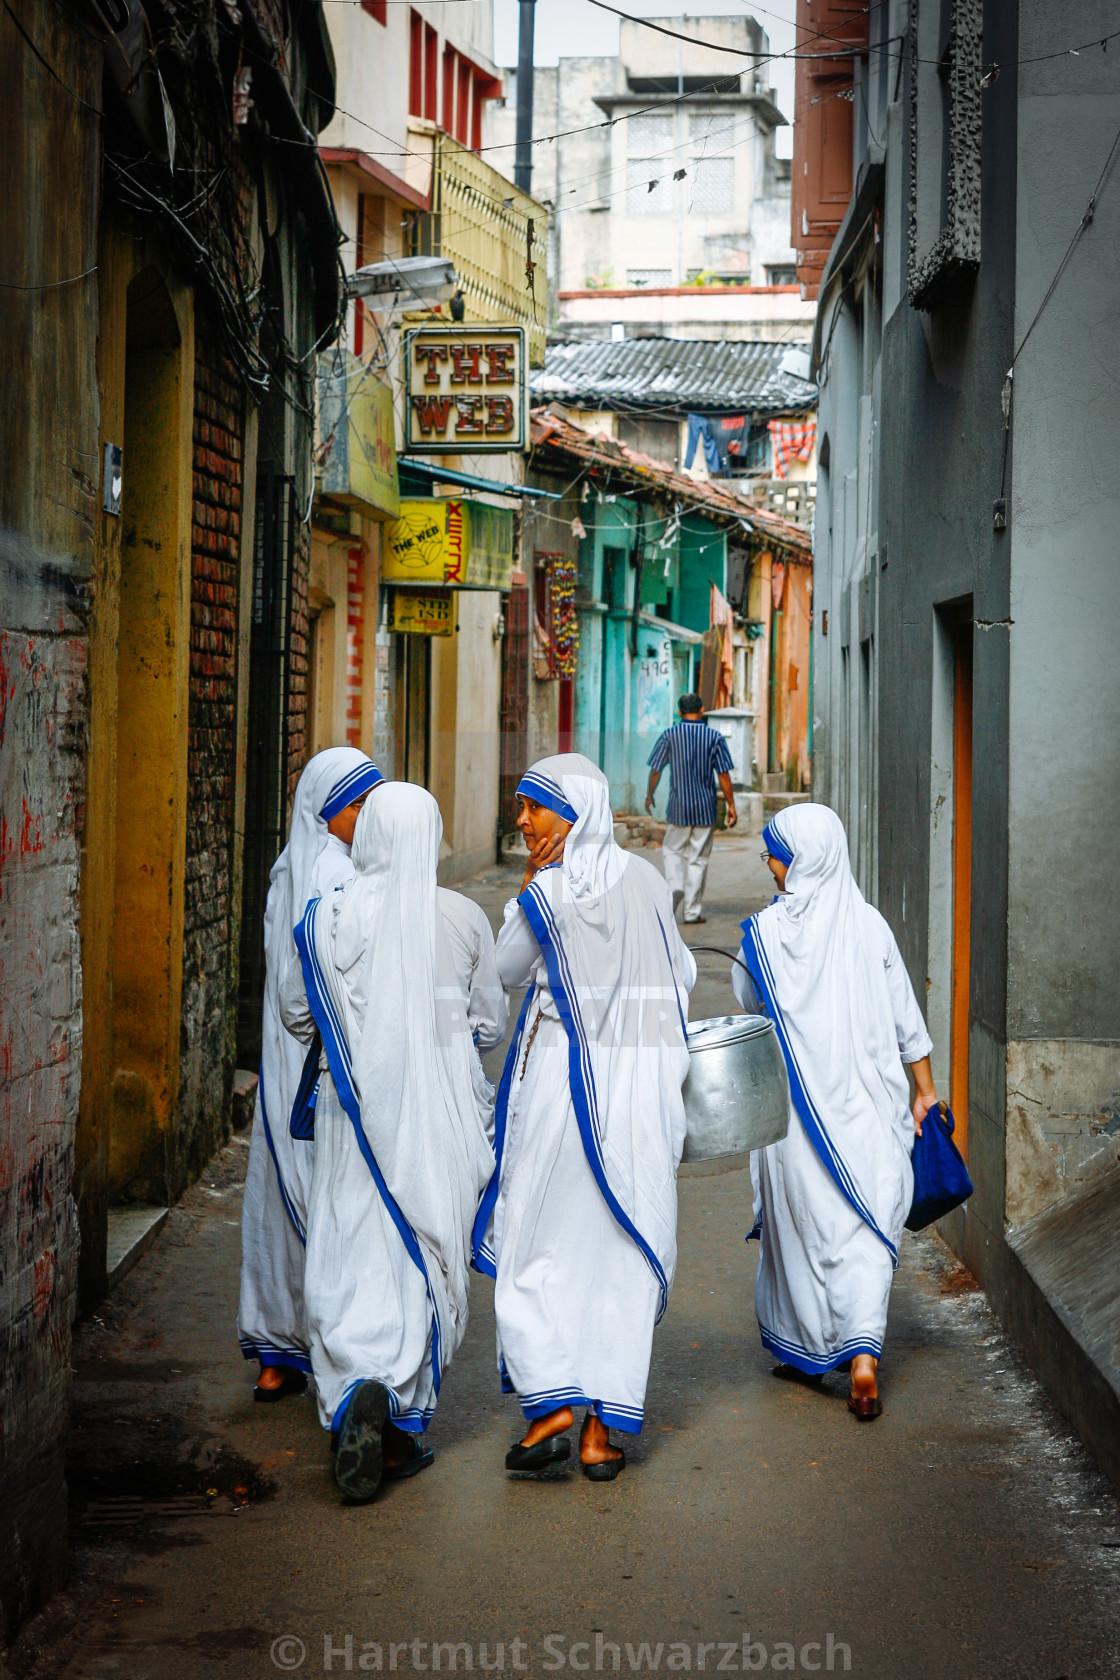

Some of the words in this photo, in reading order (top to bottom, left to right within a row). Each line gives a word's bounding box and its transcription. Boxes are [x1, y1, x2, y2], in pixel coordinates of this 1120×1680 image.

[415, 344, 514, 383] THE
[412, 395, 515, 434] WEB
[392, 539, 415, 554] THE
[415, 526, 439, 543] WEB
[418, 599, 449, 610] STD
[418, 609, 449, 620] ISD
